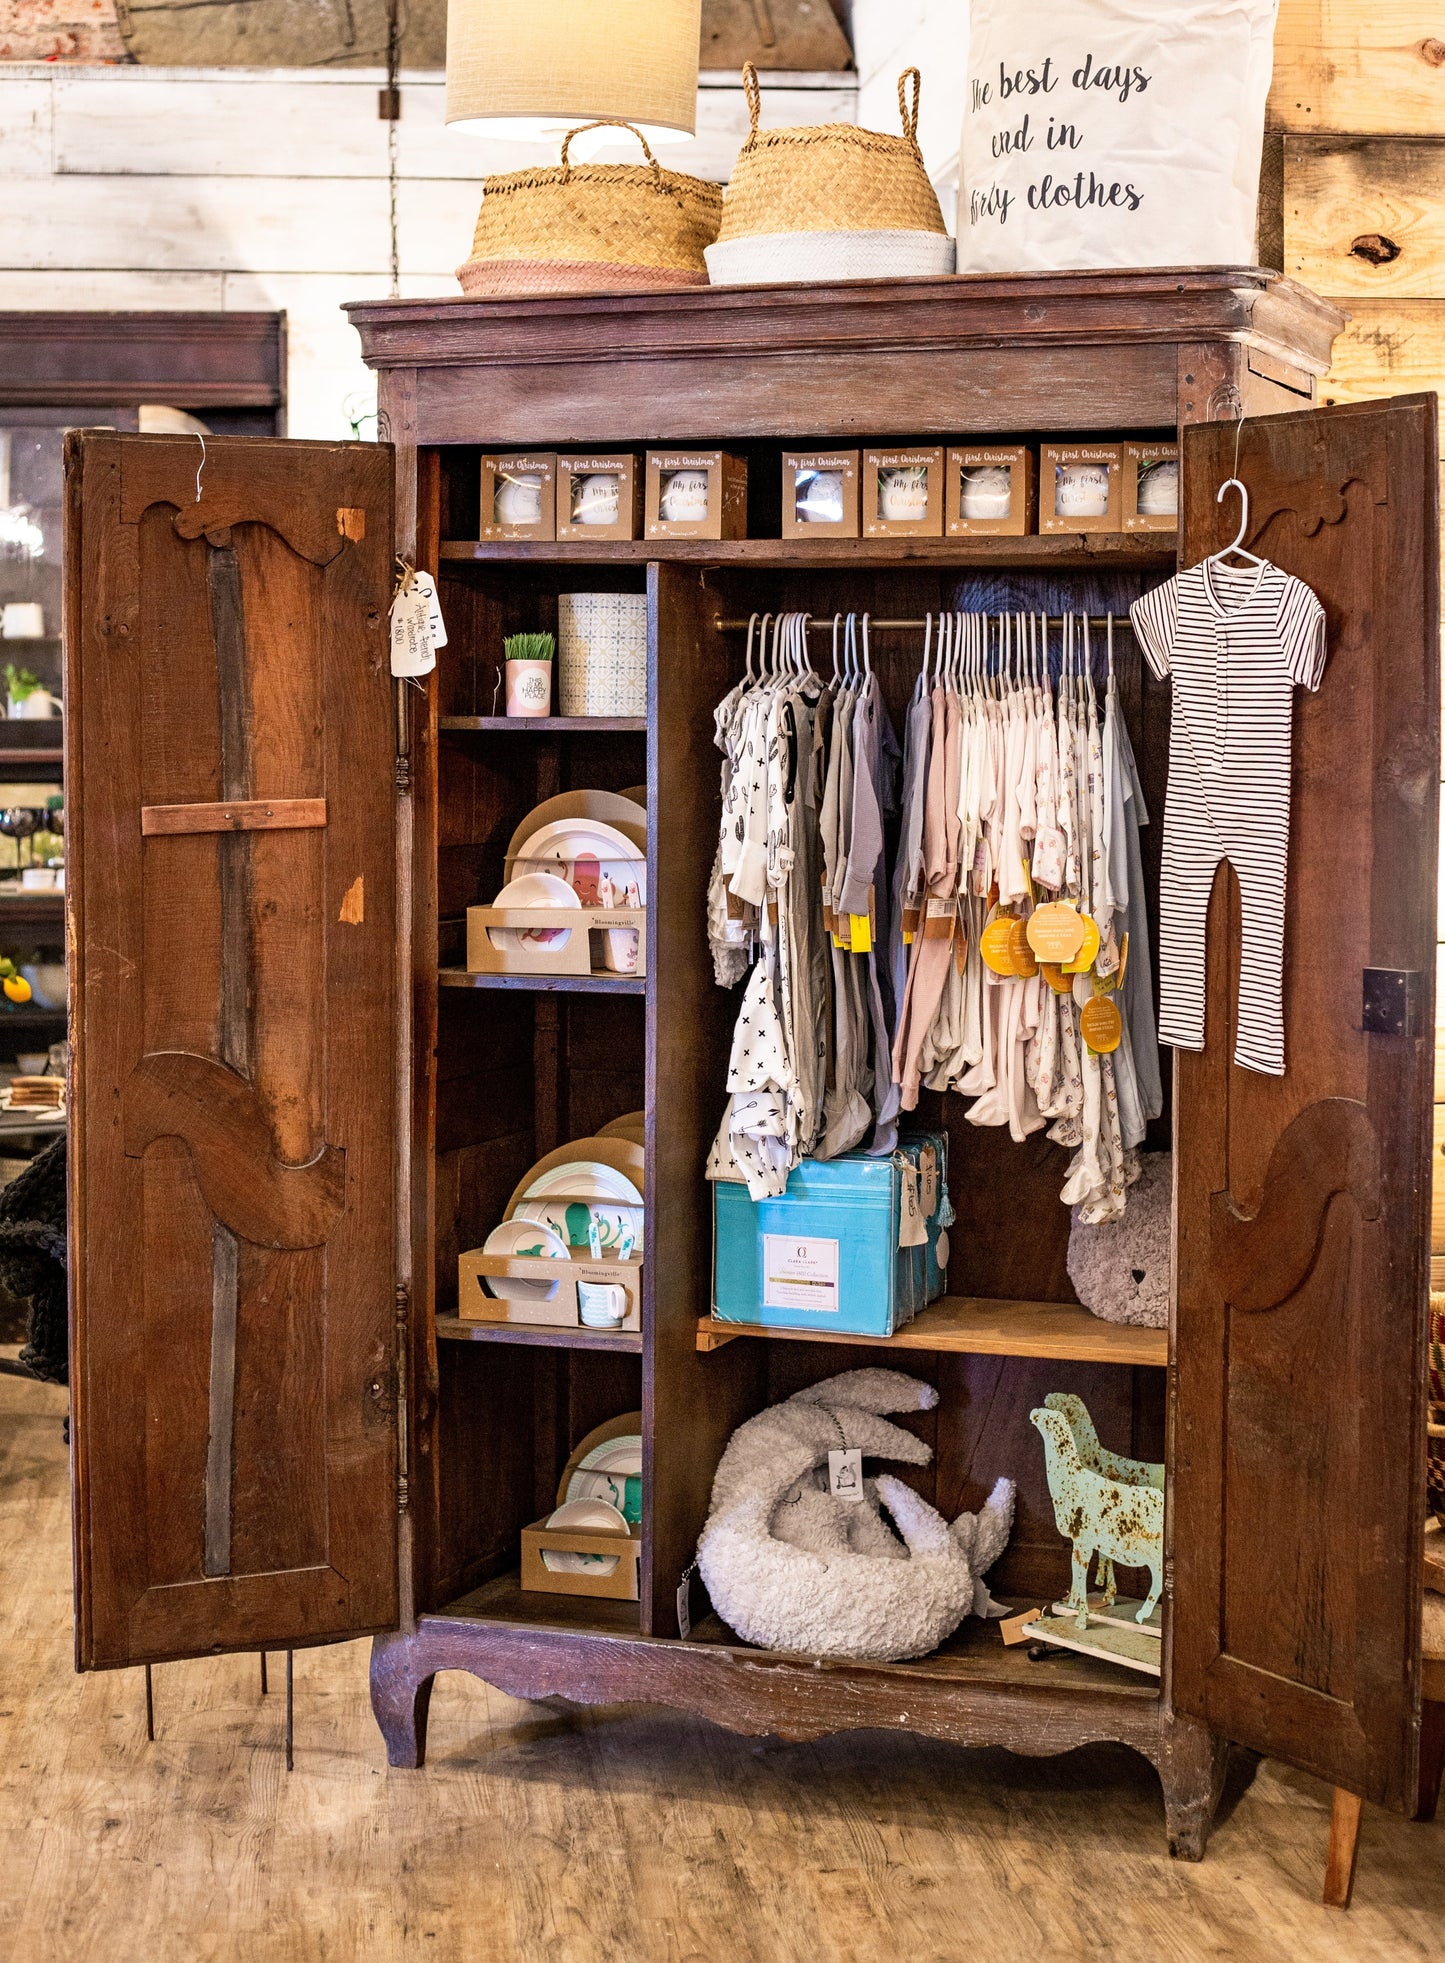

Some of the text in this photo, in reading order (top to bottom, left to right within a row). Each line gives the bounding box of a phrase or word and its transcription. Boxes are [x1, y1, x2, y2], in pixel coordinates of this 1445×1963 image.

[971, 53, 1152, 114] The best days
[991, 113, 1083, 158] end in
[1027, 171, 1145, 211] clothes
[952, 452, 1017, 464] My first Christmas
[1047, 448, 1117, 461] My first Christmas
[1128, 447, 1140, 459] My
[1141, 447, 1159, 459] first
[486, 460, 549, 471] My first Christmas
[561, 459, 624, 471] My first Christmas
[651, 456, 714, 468] My first Christmas
[787, 457, 850, 469] My first Christmas
[868, 453, 934, 467] My first Christmas
[672, 481, 685, 492] My
[893, 479, 907, 491] My
[1062, 475, 1103, 488] My first
